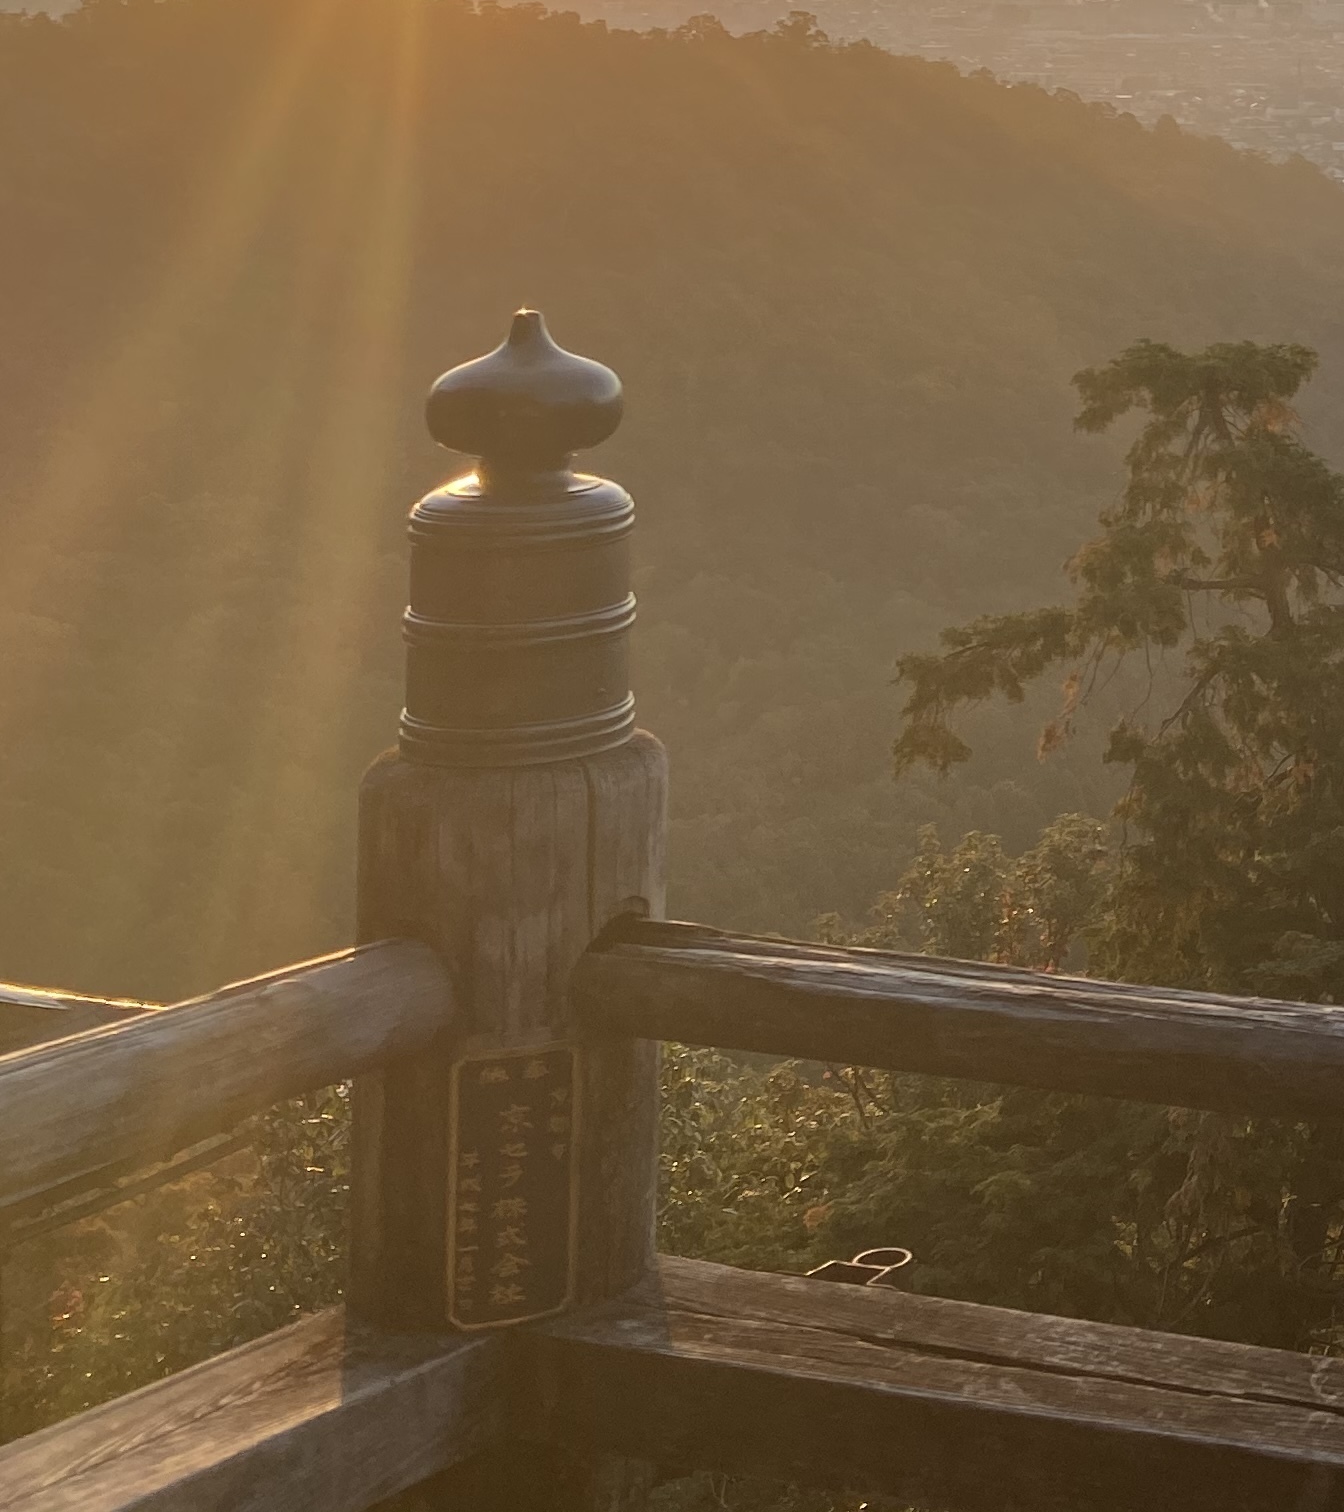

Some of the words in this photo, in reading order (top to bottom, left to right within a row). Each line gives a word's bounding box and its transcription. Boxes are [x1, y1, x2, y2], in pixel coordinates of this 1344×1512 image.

[489, 1103, 533, 1305] 京セラ株式会社
